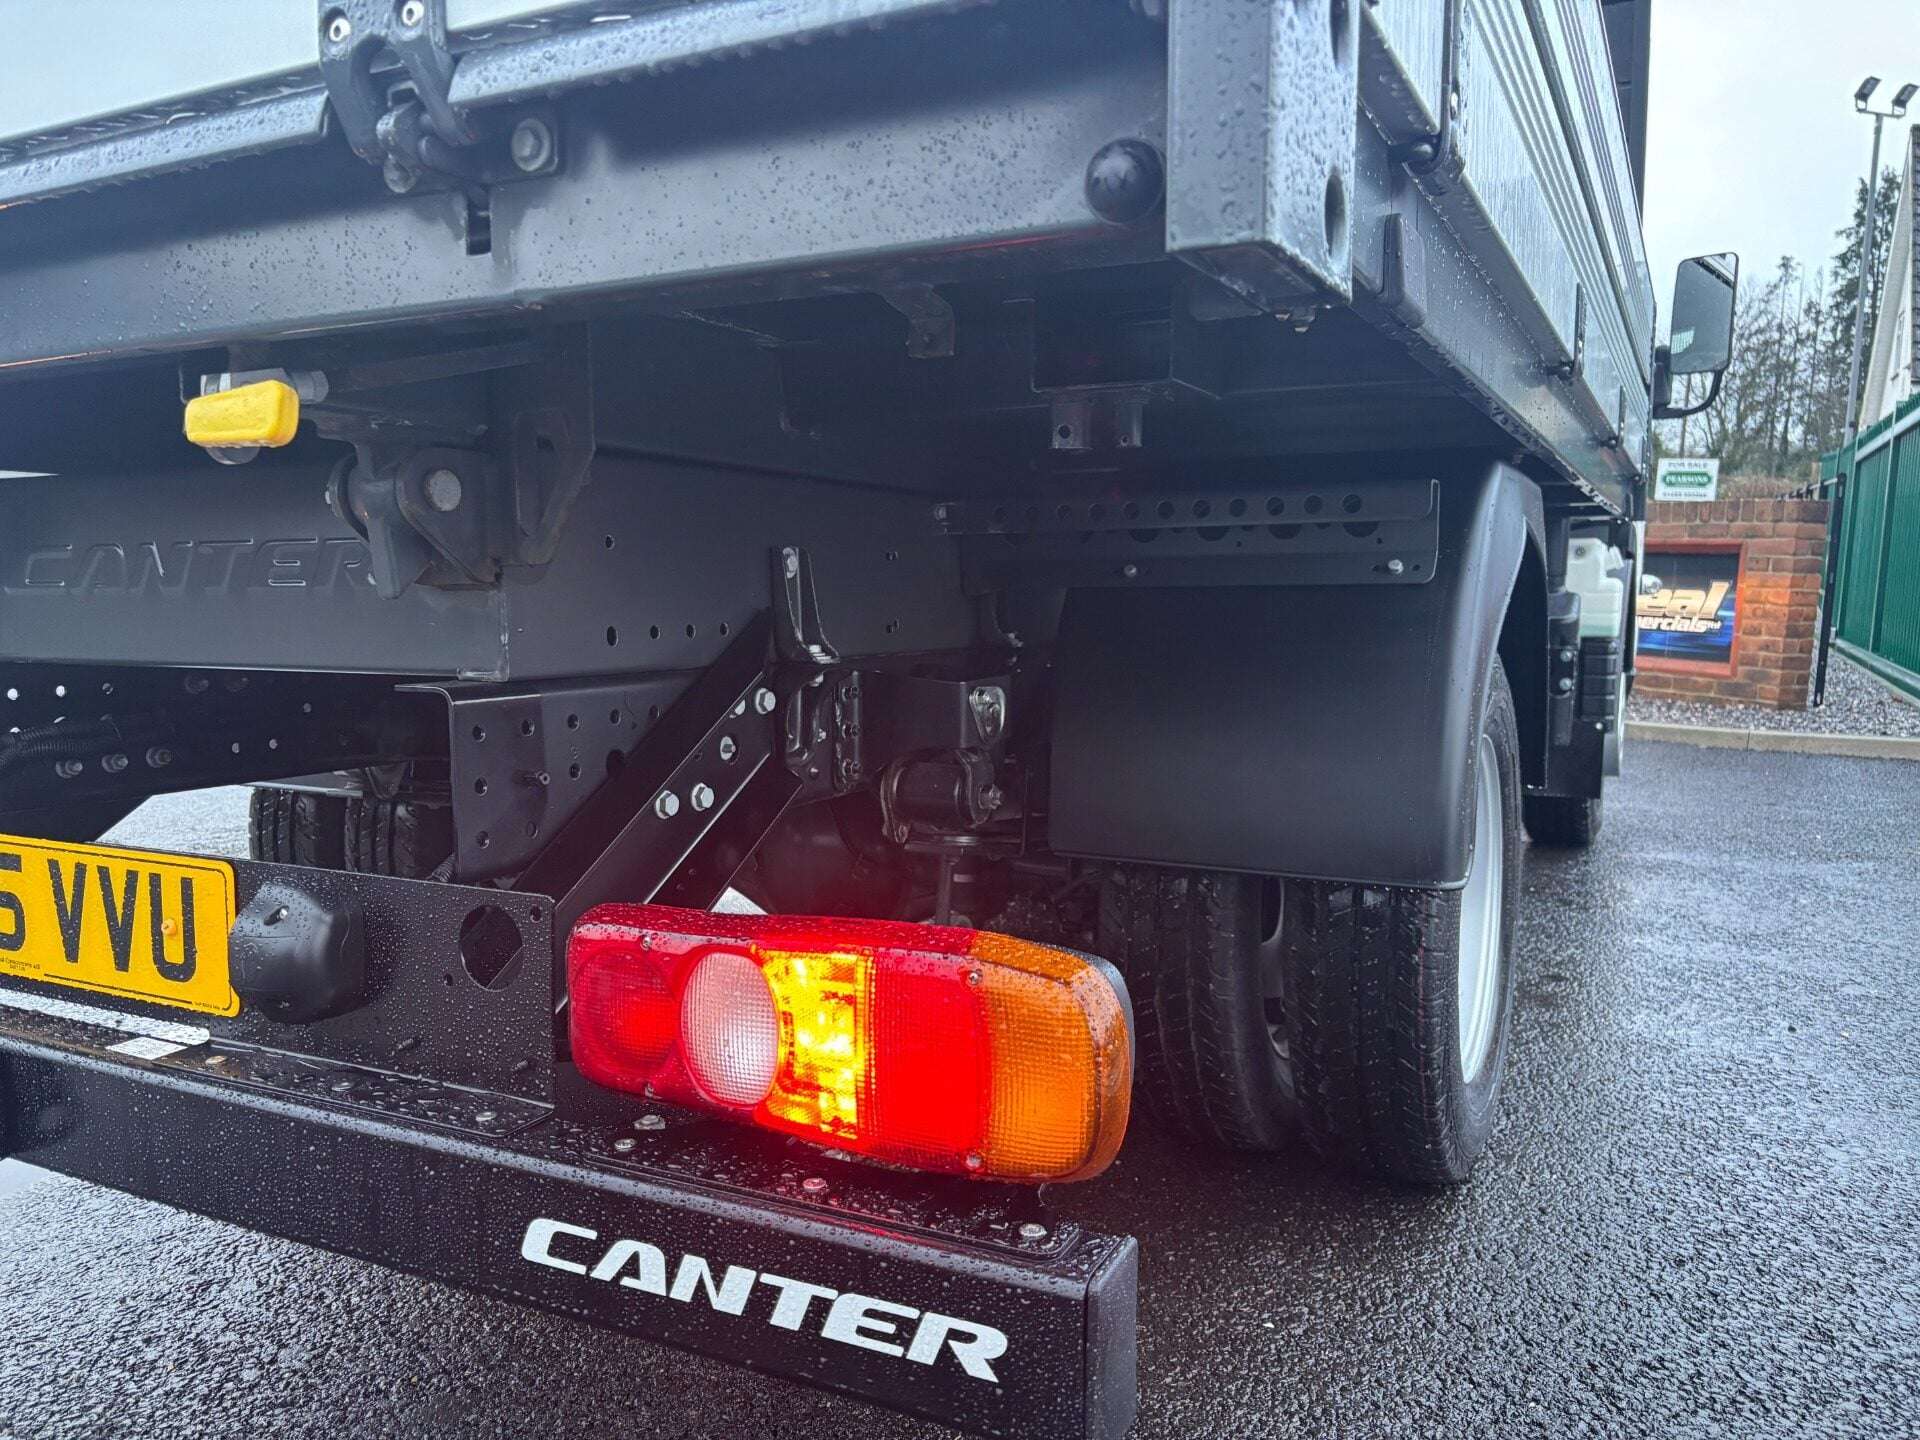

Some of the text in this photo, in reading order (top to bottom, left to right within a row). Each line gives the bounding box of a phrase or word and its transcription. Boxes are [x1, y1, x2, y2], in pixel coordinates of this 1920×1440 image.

[6, 537, 377, 592] CANTER
[1636, 581, 1730, 619] eal
[1636, 614, 1708, 633] ercials
[47, 858, 197, 983] VVU
[520, 1217, 1009, 1383] CANTER
